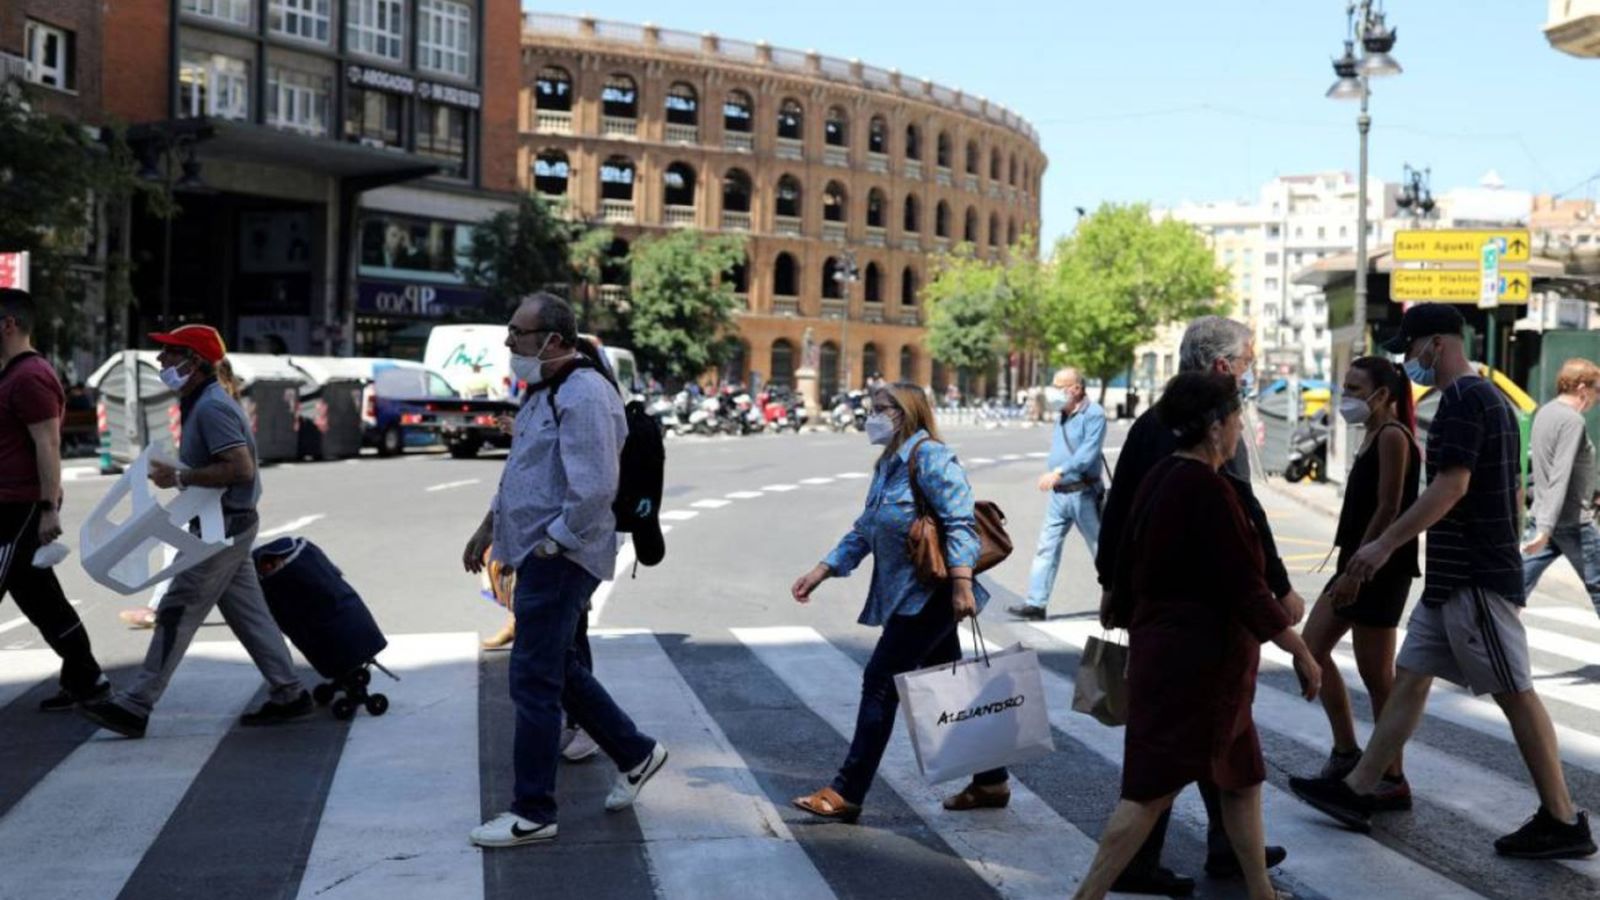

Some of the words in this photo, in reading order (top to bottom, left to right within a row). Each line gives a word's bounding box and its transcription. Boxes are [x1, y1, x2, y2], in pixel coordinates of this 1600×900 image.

[1397, 241, 1425, 251] Sant
[1440, 287, 1478, 297] Centra
[936, 694, 1025, 726] ALEJANDRO
